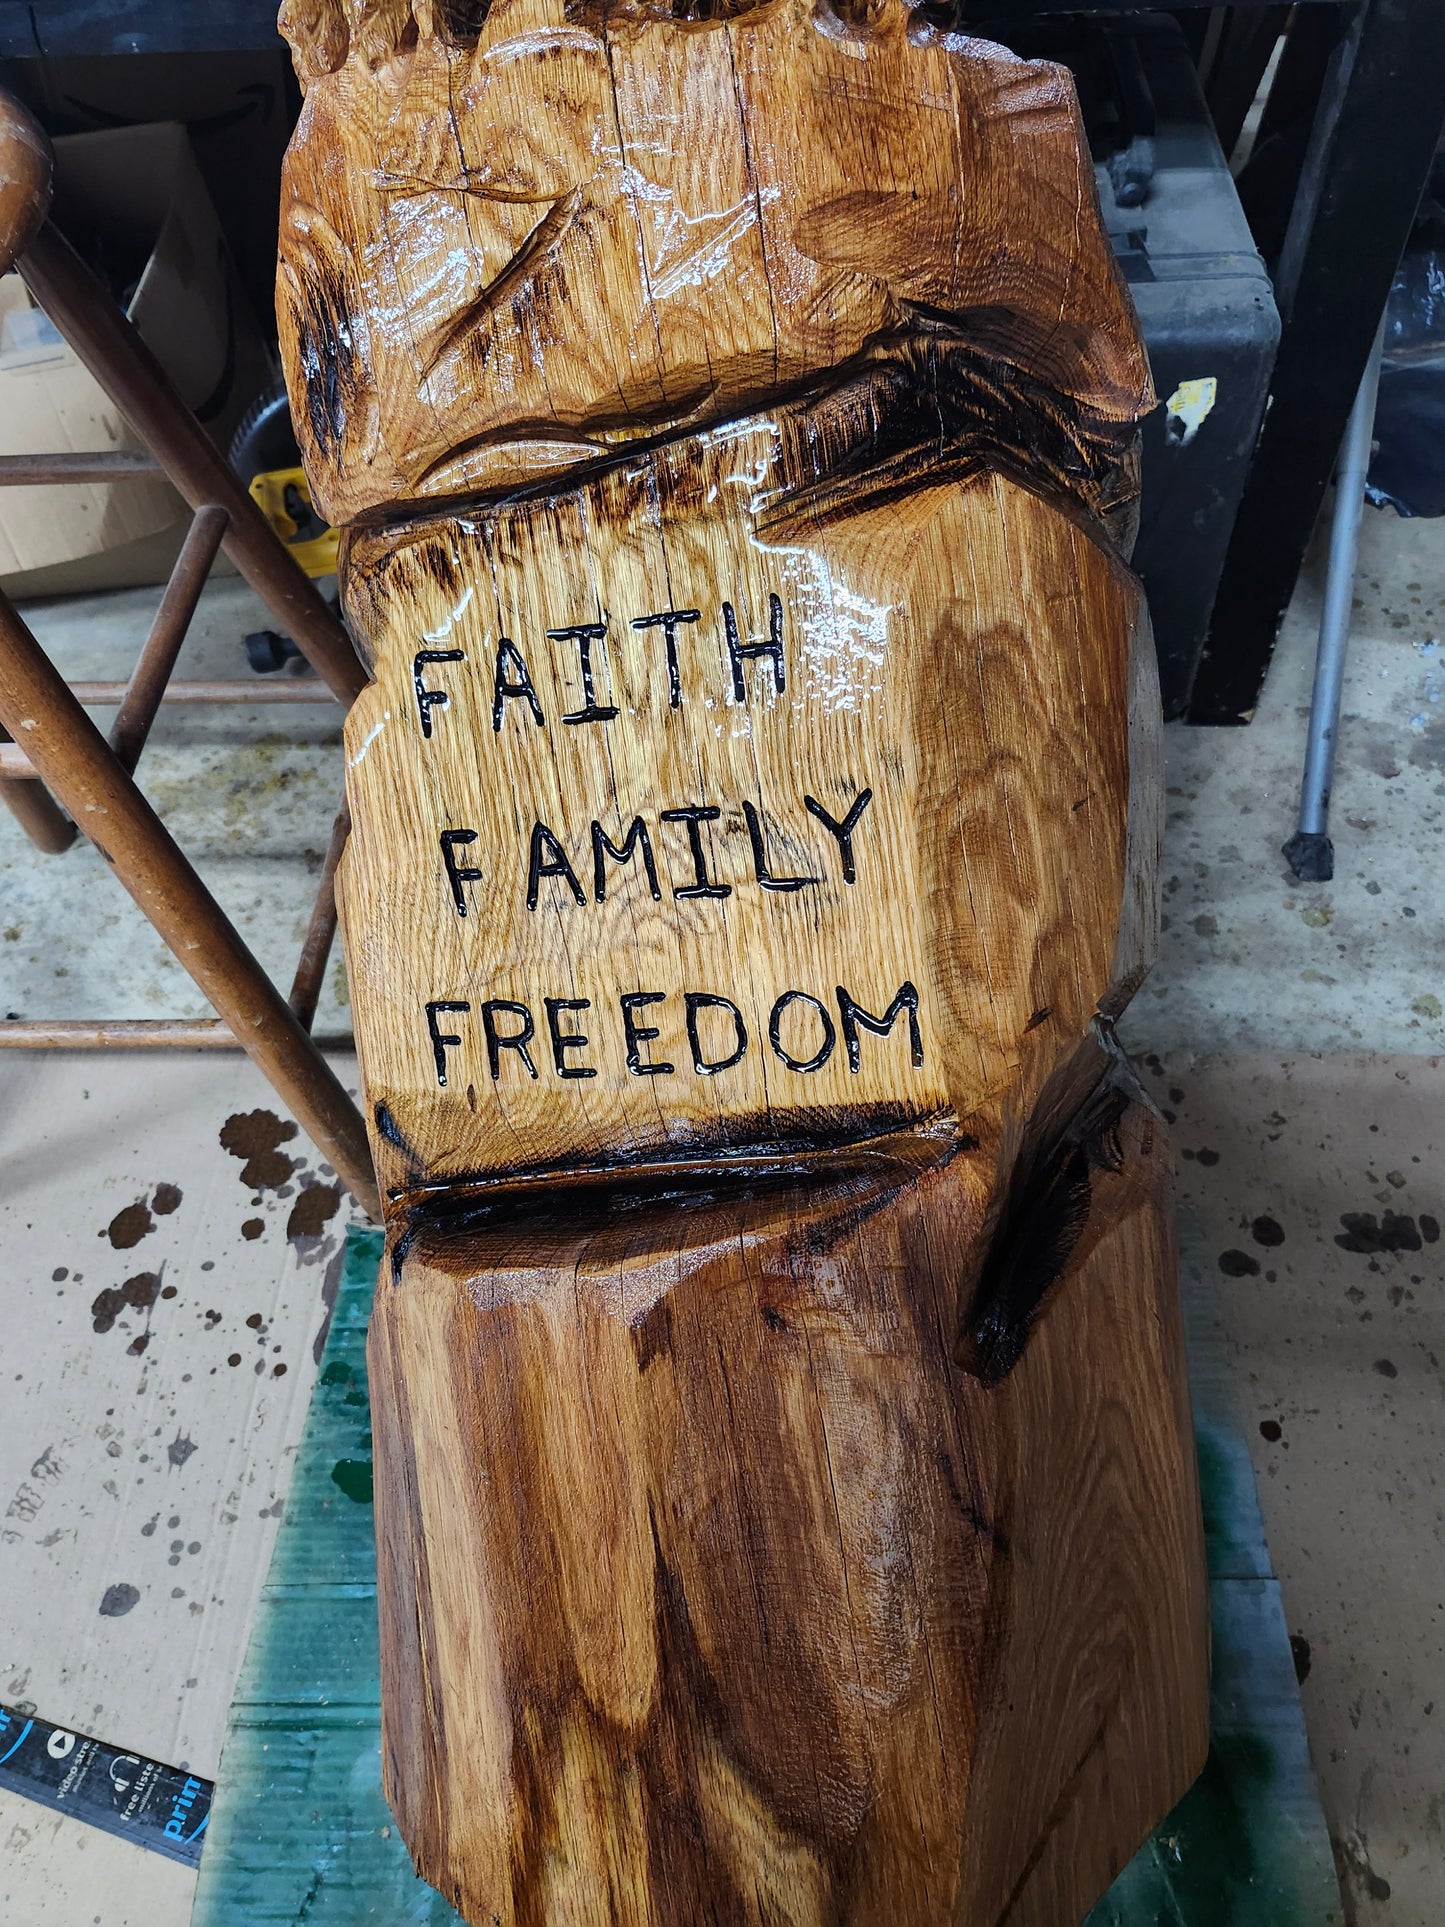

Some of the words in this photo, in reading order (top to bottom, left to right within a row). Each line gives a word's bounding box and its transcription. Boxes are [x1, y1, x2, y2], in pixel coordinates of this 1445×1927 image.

[413, 593, 786, 738] FAITH
[439, 788, 873, 918] FAMILY
[425, 981, 925, 1087] FREEDOM
[57, 1766, 78, 1799] video
[74, 1740, 92, 1766] stre
[120, 1793, 140, 1821] free
[134, 1763, 154, 1791] liste
